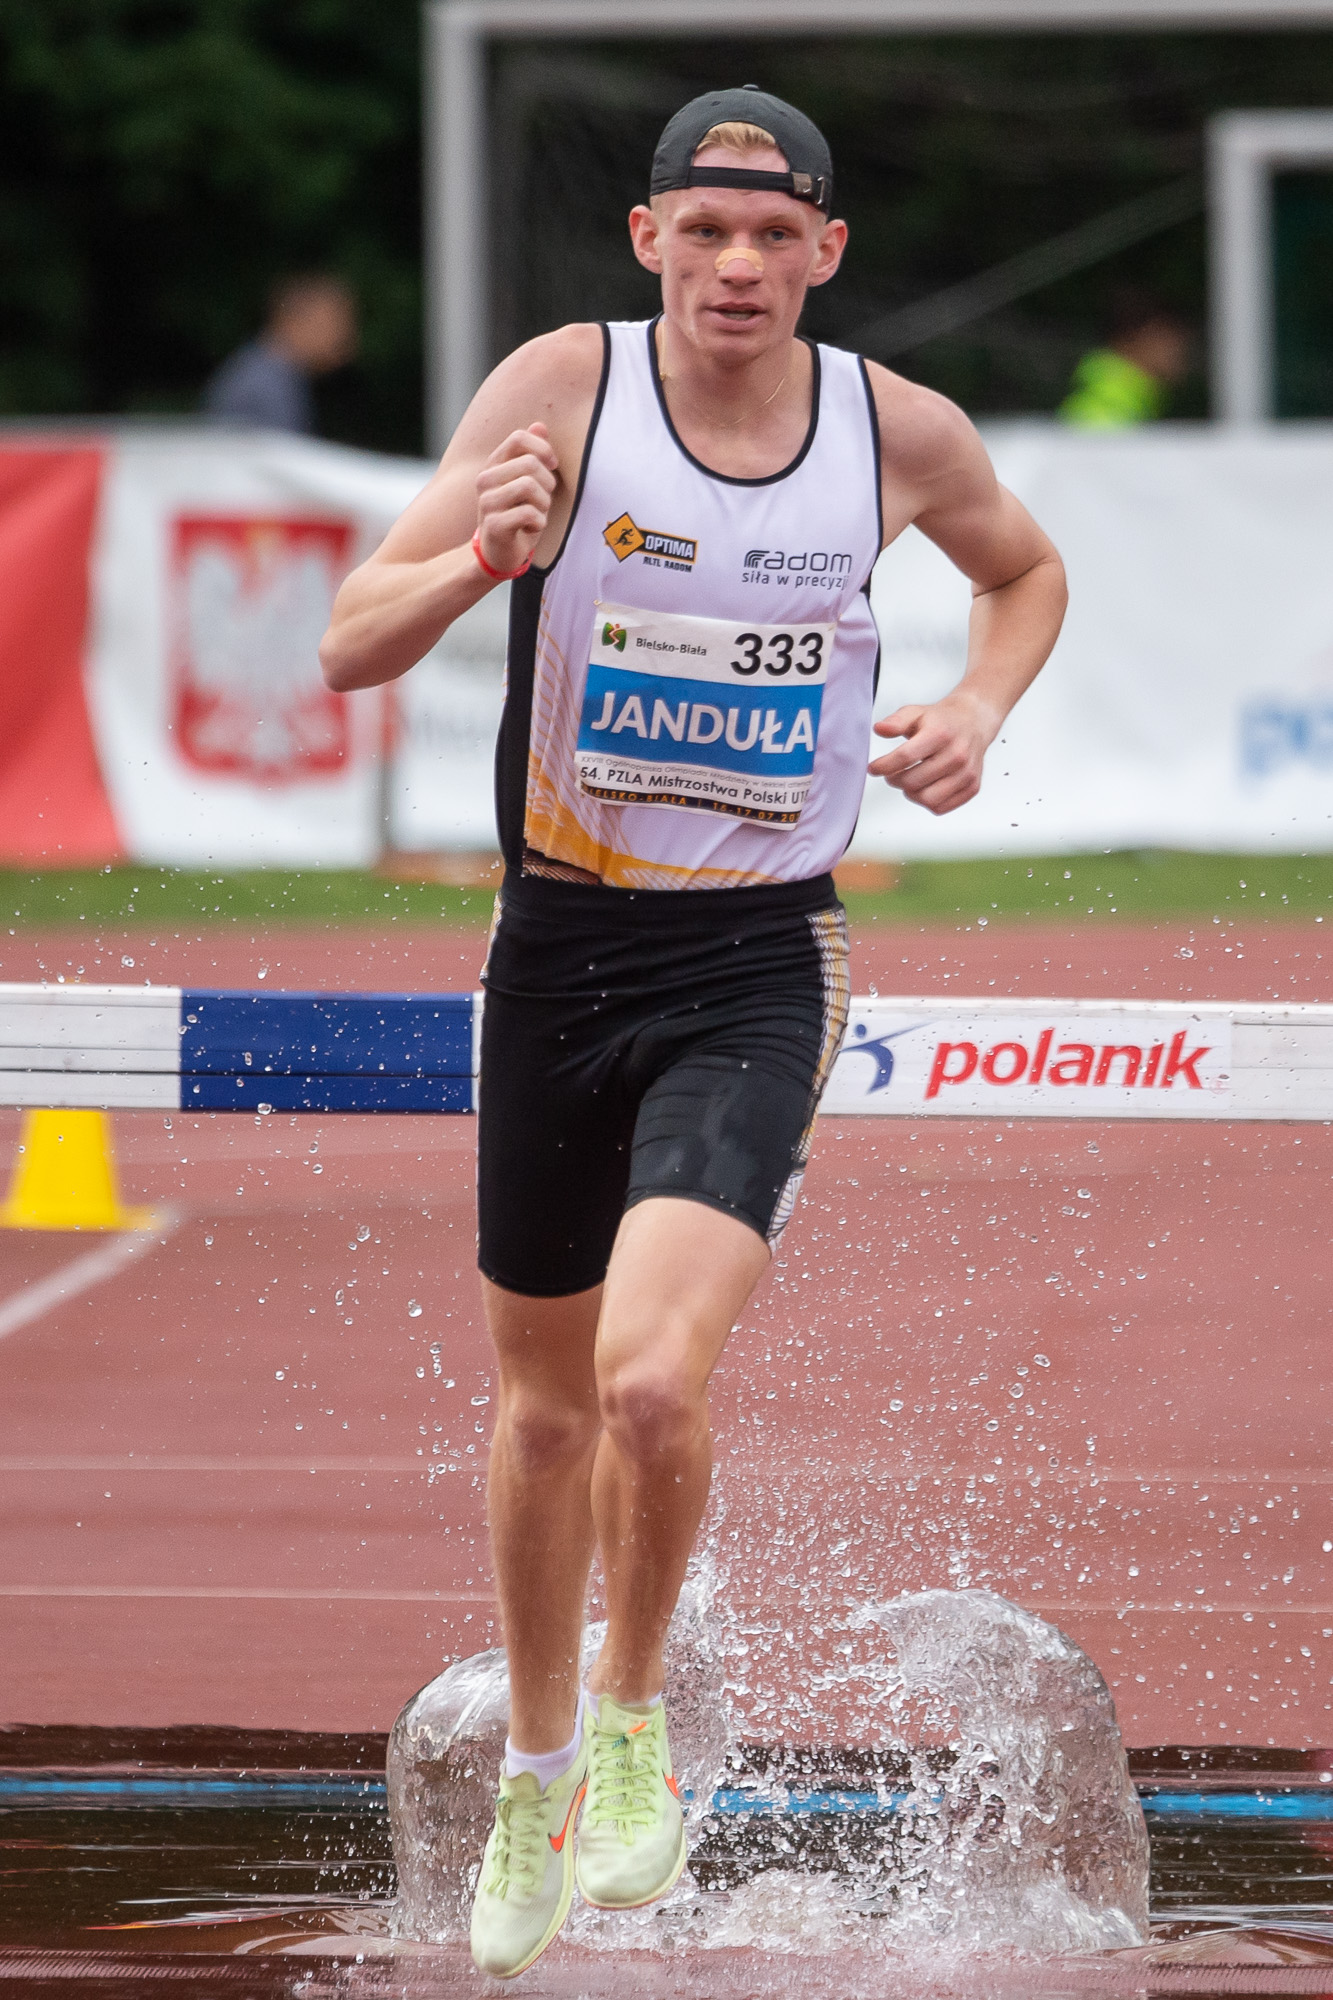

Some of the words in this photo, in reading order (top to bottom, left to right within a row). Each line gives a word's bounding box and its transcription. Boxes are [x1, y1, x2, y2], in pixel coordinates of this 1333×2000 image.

[645, 535, 694, 559] OPTIMA
[664, 560, 692, 573] RADOM
[743, 549, 853, 574] radom
[741, 570, 770, 586] siła
[777, 575, 790, 586] w
[636, 637, 707, 656] Bielsko-Biała
[729, 632, 824, 677] 333
[590, 691, 815, 755] JANDUŁA
[580, 766, 601, 781] 54.
[607, 769, 643, 787] PZLA
[648, 775, 739, 798] Mistrzostwa
[743, 788, 788, 805] Polski
[923, 1027, 1213, 1101] polanik
